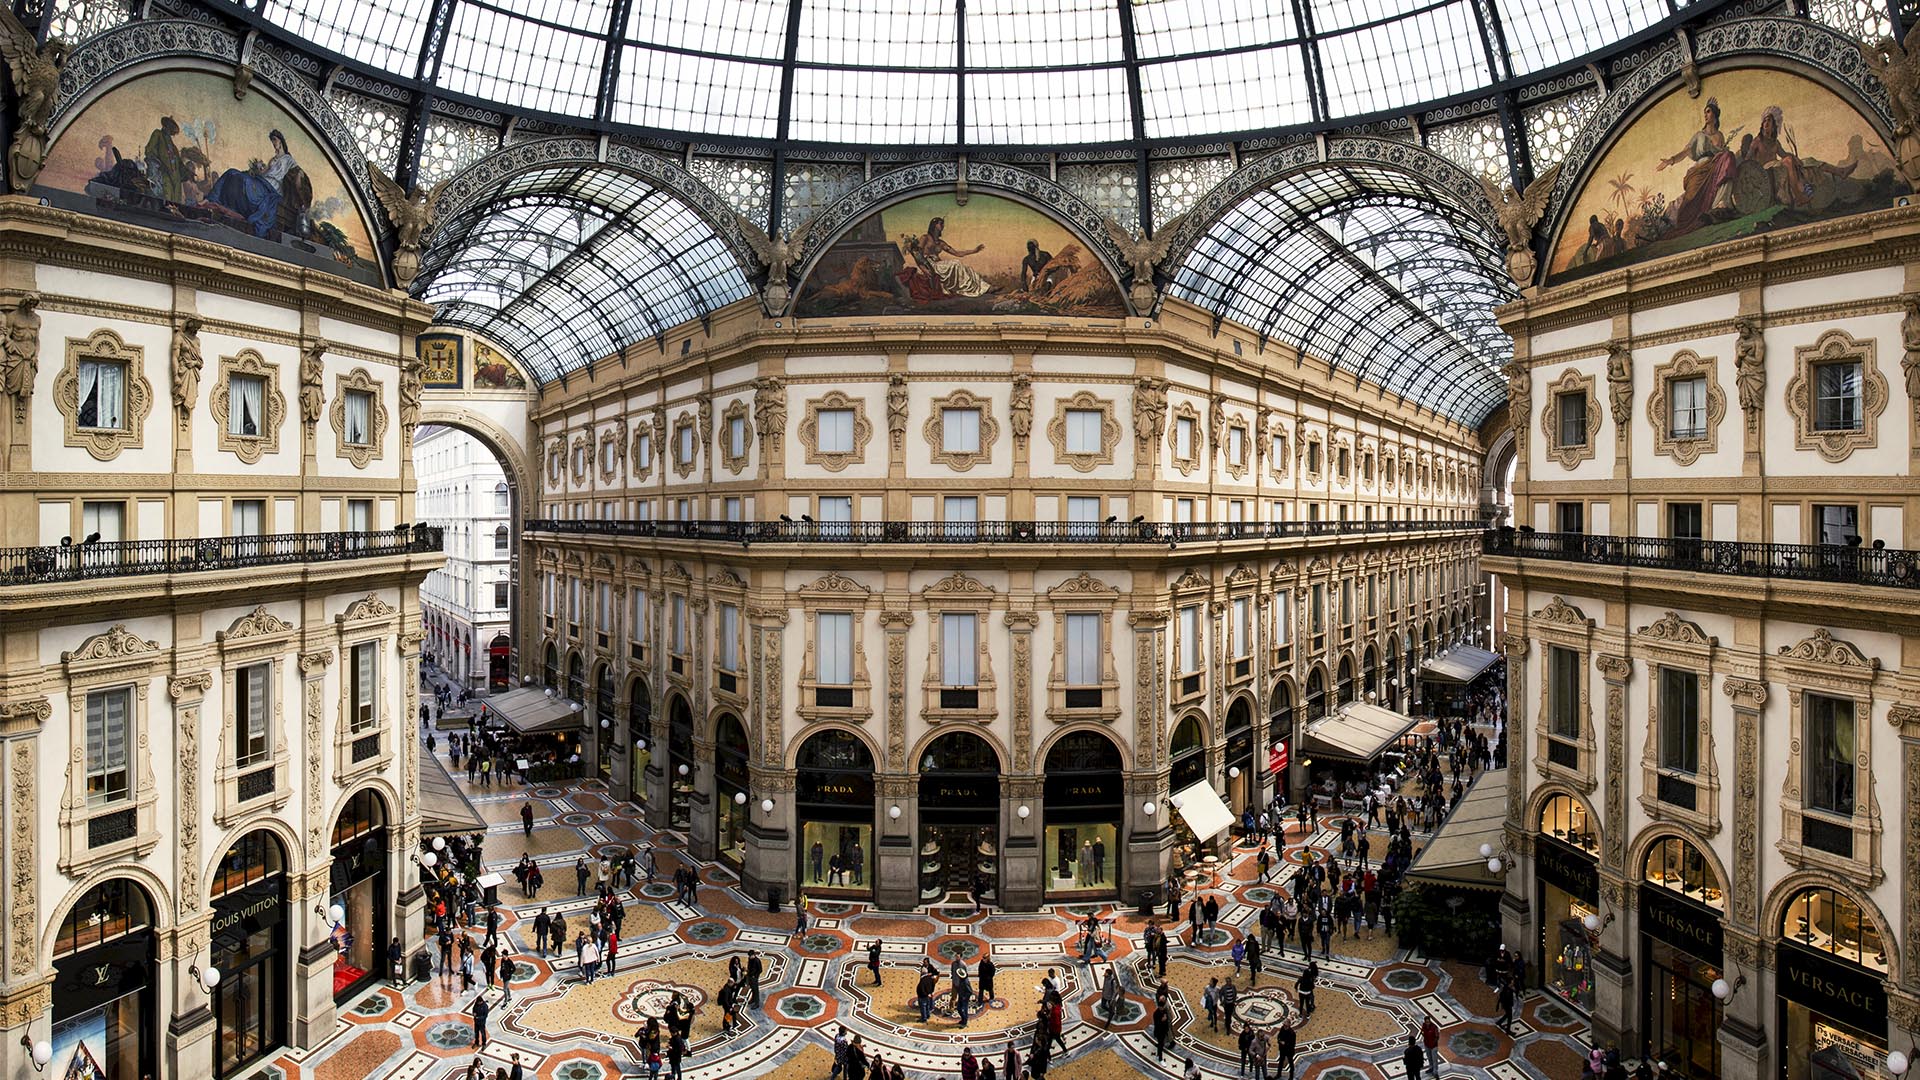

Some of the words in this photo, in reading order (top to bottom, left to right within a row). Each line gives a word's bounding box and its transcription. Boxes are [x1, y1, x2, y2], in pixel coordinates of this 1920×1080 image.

[816, 784, 854, 794] PRADA
[940, 788, 978, 797] PRADA
[1542, 853, 1592, 888] VERSACE
[212, 912, 239, 933] LOUIS
[241, 894, 279, 919] VUITTON
[1649, 905, 1713, 946] VERSACE
[95, 963, 110, 986] LV
[1789, 967, 1875, 1013] VERSACE
[1829, 1032, 1860, 1051] VERSACE
